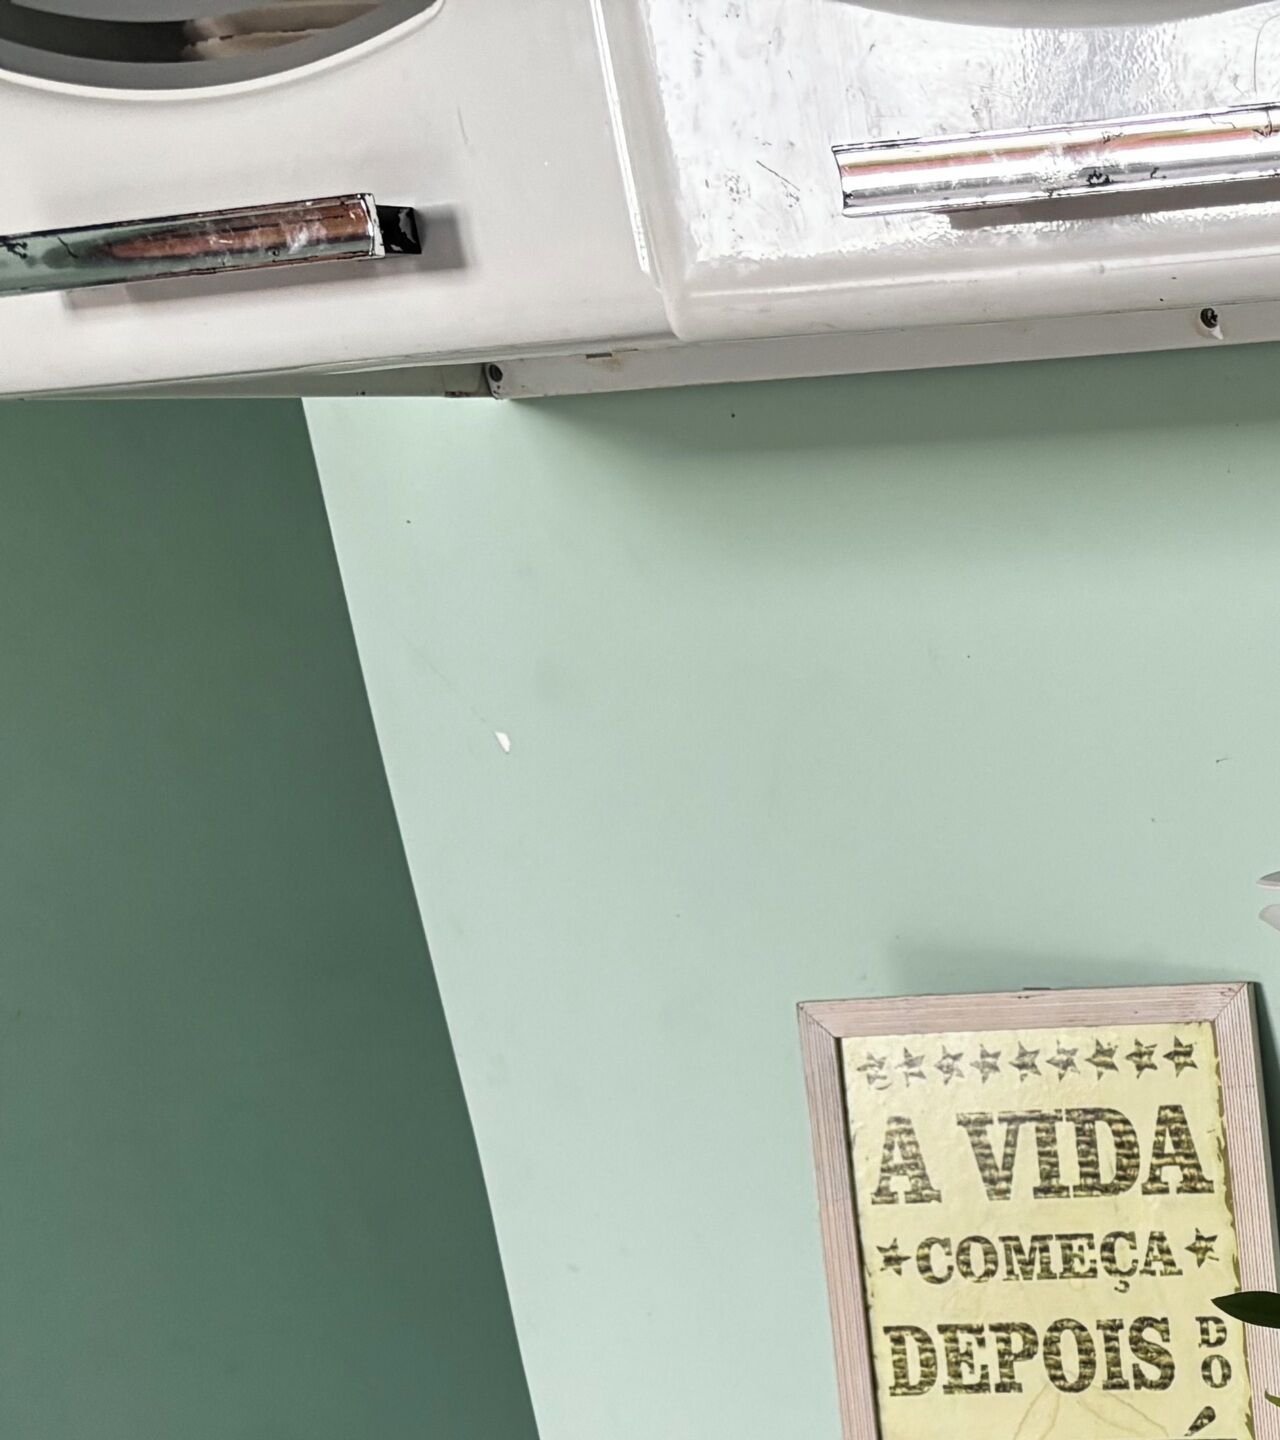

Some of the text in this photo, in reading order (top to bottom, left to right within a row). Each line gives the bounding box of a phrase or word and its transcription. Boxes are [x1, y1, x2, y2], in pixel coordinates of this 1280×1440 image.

[871, 1104, 1214, 1204] A VIDA
[917, 1231, 1183, 1292] COMEÇA
[883, 1316, 1177, 1396] DEPOIS
[1195, 1316, 1232, 1389] DO
